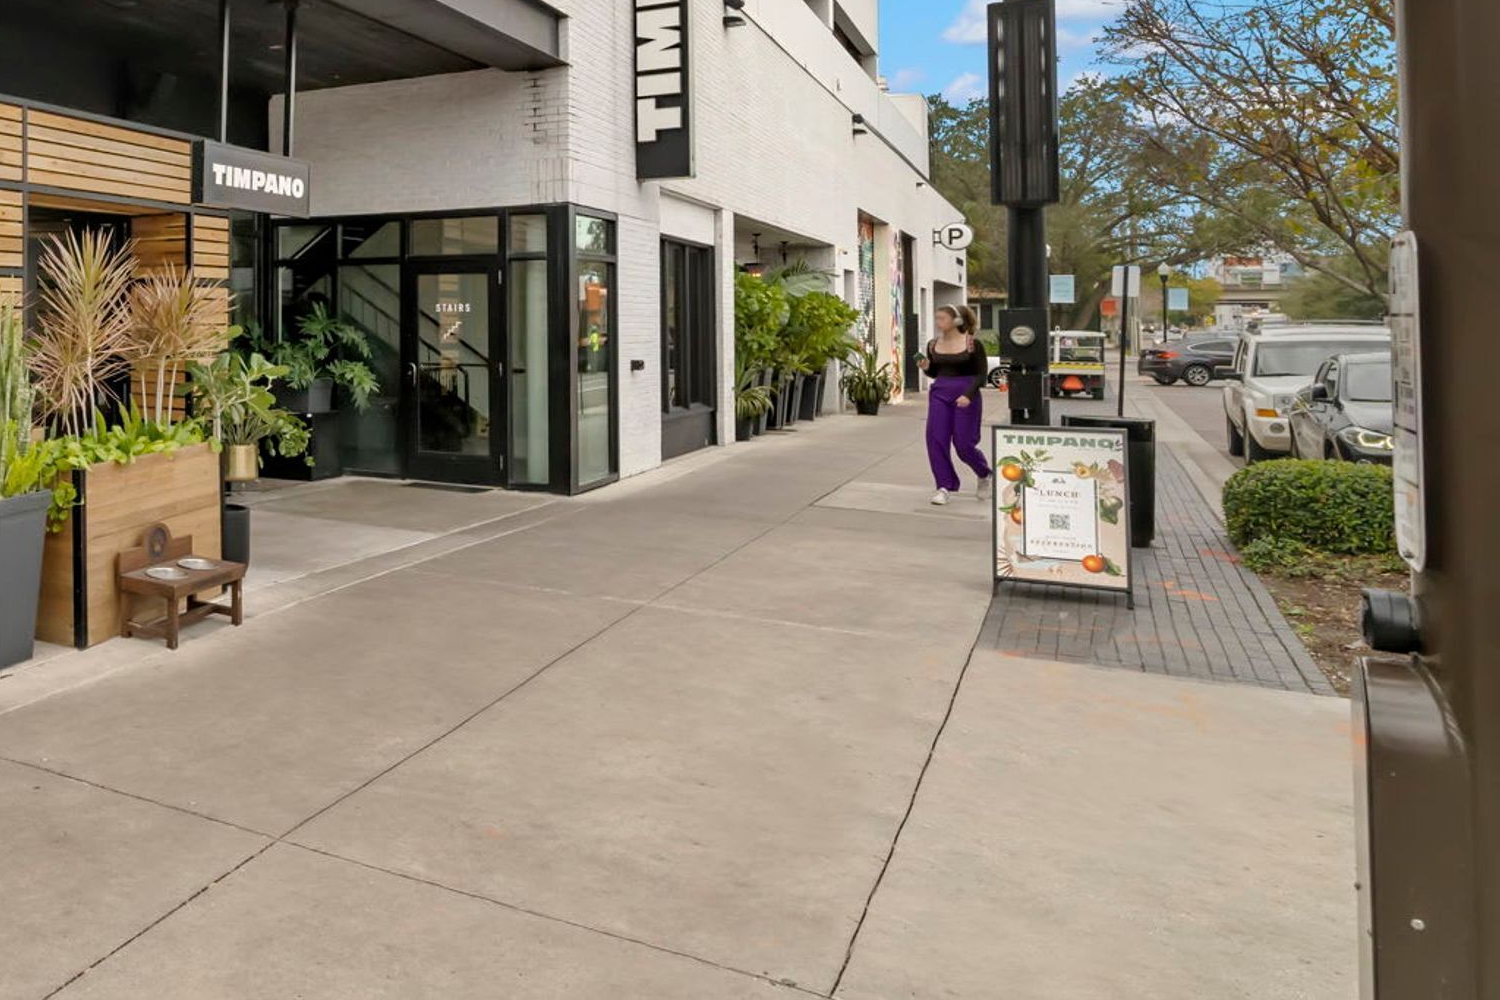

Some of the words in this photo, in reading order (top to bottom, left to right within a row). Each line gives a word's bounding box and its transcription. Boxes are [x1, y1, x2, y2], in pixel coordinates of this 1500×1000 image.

[212, 162, 305, 199] TIMPANO
[948, 228, 963, 245] P
[435, 303, 471, 313] STAIRS
[1002, 434, 1114, 450] TIMPANO
[1039, 489, 1079, 499] LUNCH
